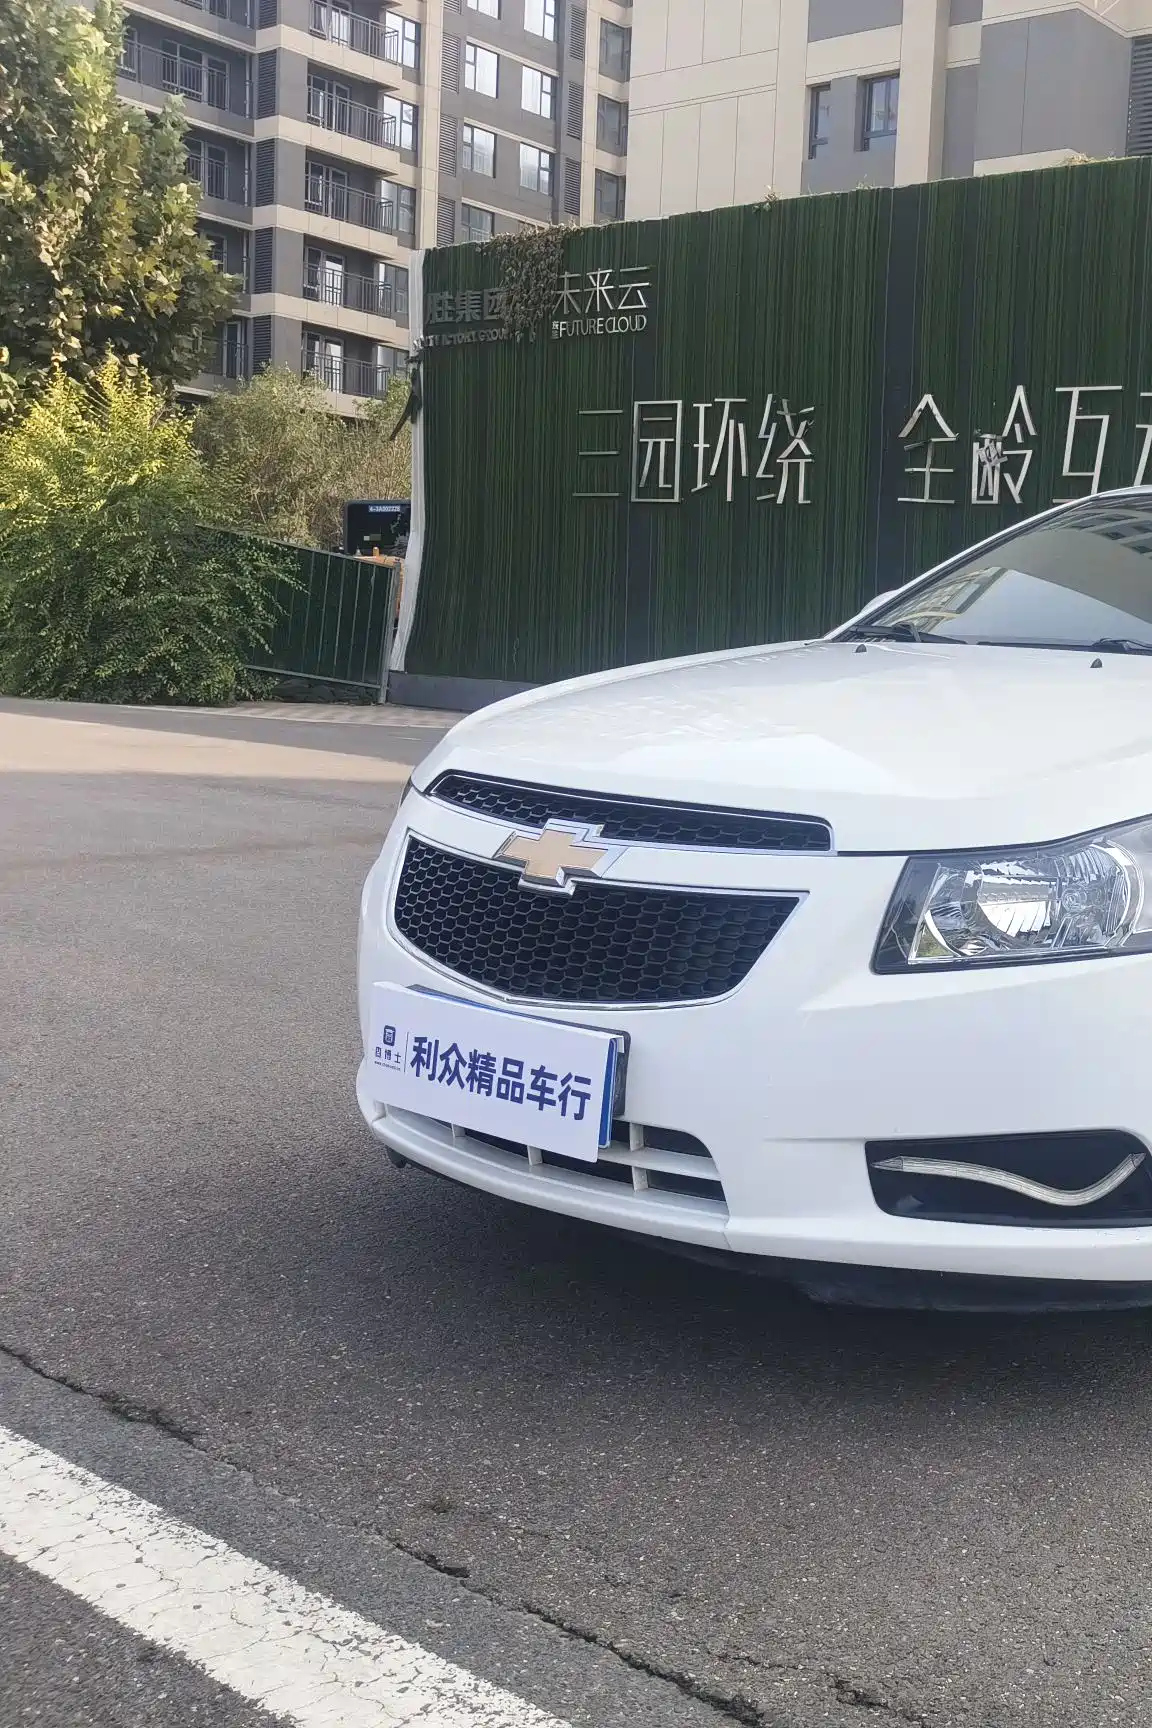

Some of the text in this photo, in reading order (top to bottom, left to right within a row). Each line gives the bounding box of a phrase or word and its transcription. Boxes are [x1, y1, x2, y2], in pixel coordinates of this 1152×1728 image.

[551, 265, 651, 315] 未来云
[559, 317, 604, 338] FUTURE
[605, 314, 647, 334] CLOUD
[572, 394, 815, 504] 三园环绕
[410, 1036, 591, 1121] 利众精品车行
